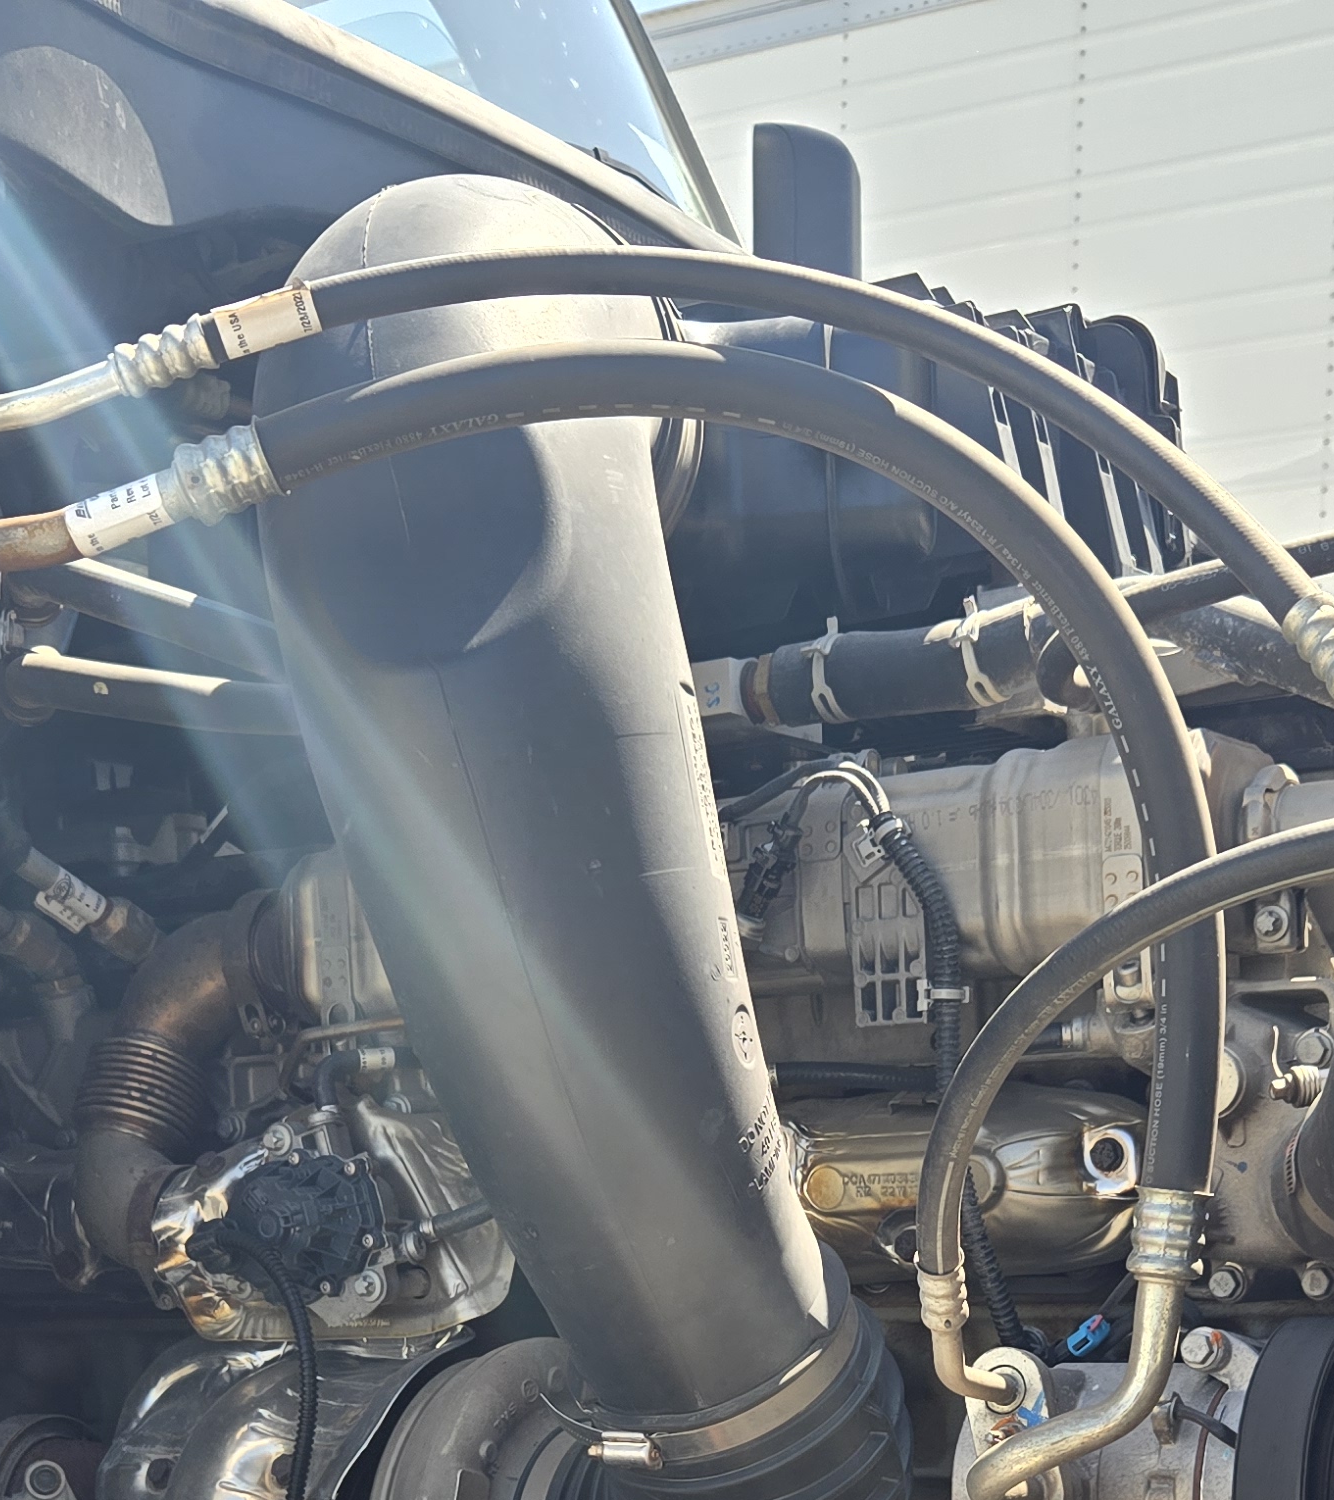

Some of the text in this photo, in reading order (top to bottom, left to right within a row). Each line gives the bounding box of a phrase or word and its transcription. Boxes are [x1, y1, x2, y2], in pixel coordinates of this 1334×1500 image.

[228, 312, 243, 333] USA
[395, 431, 423, 446] 4880
[428, 413, 499, 438] GALAXY
[816, 431, 856, 452] (19mm)
[856, 447, 891, 471] HOSE
[890, 465, 938, 499] SUCTION
[939, 494, 958, 512] A/C
[958, 510, 997, 545] R-1234yf
[1002, 547, 1031, 580] R-134a
[1031, 581, 1077, 636] FlexBarrier
[1070, 636, 1090, 661] 4880
[1086, 664, 1123, 730] GALAXY
[1159, 1016, 1167, 1034] 3/4
[1156, 1037, 1167, 1079] (19mm)
[1153, 1082, 1163, 1117] HOSE
[1146, 1122, 1160, 1173] SUCTION
